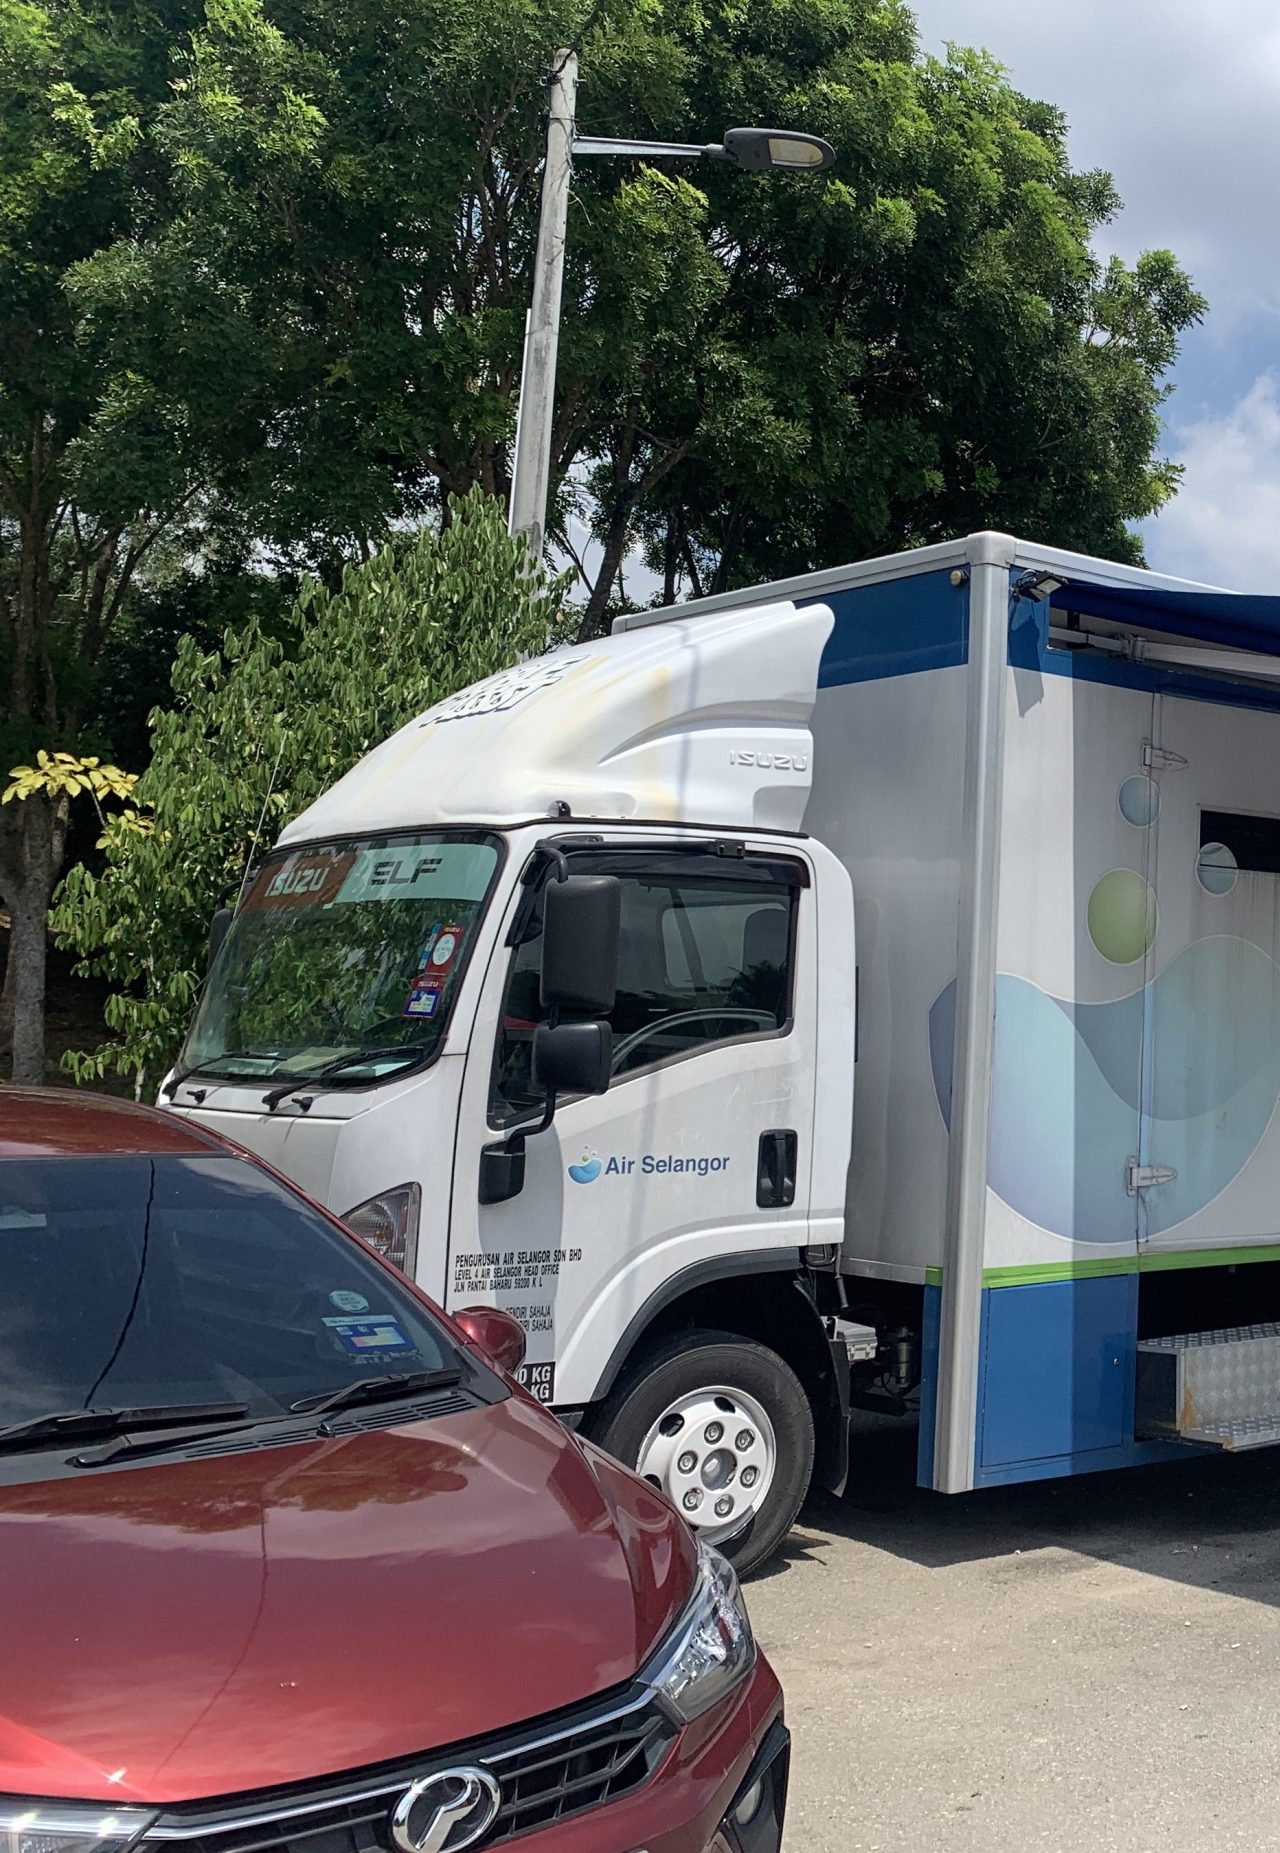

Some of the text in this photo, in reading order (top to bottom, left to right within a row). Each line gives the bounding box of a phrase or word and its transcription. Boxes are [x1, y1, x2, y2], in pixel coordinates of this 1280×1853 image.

[730, 750, 807, 772] ISUZU
[264, 858, 443, 898] ISUZU ELF
[605, 1155, 730, 1176] Air Selangor
[455, 1248, 582, 1268] PENGURUSAN AIR SELANGOR SDN BHD
[454, 1264, 559, 1280] LEVEL 4 AIR SELANGOR HEAD OFFICE
[454, 1277, 543, 1292] JLN PANTAI BAHARU 59200 K L
[529, 1304, 551, 1319] SAHAJA
[532, 1319, 554, 1332] SAHAJA
[531, 1366, 551, 1384] KG
